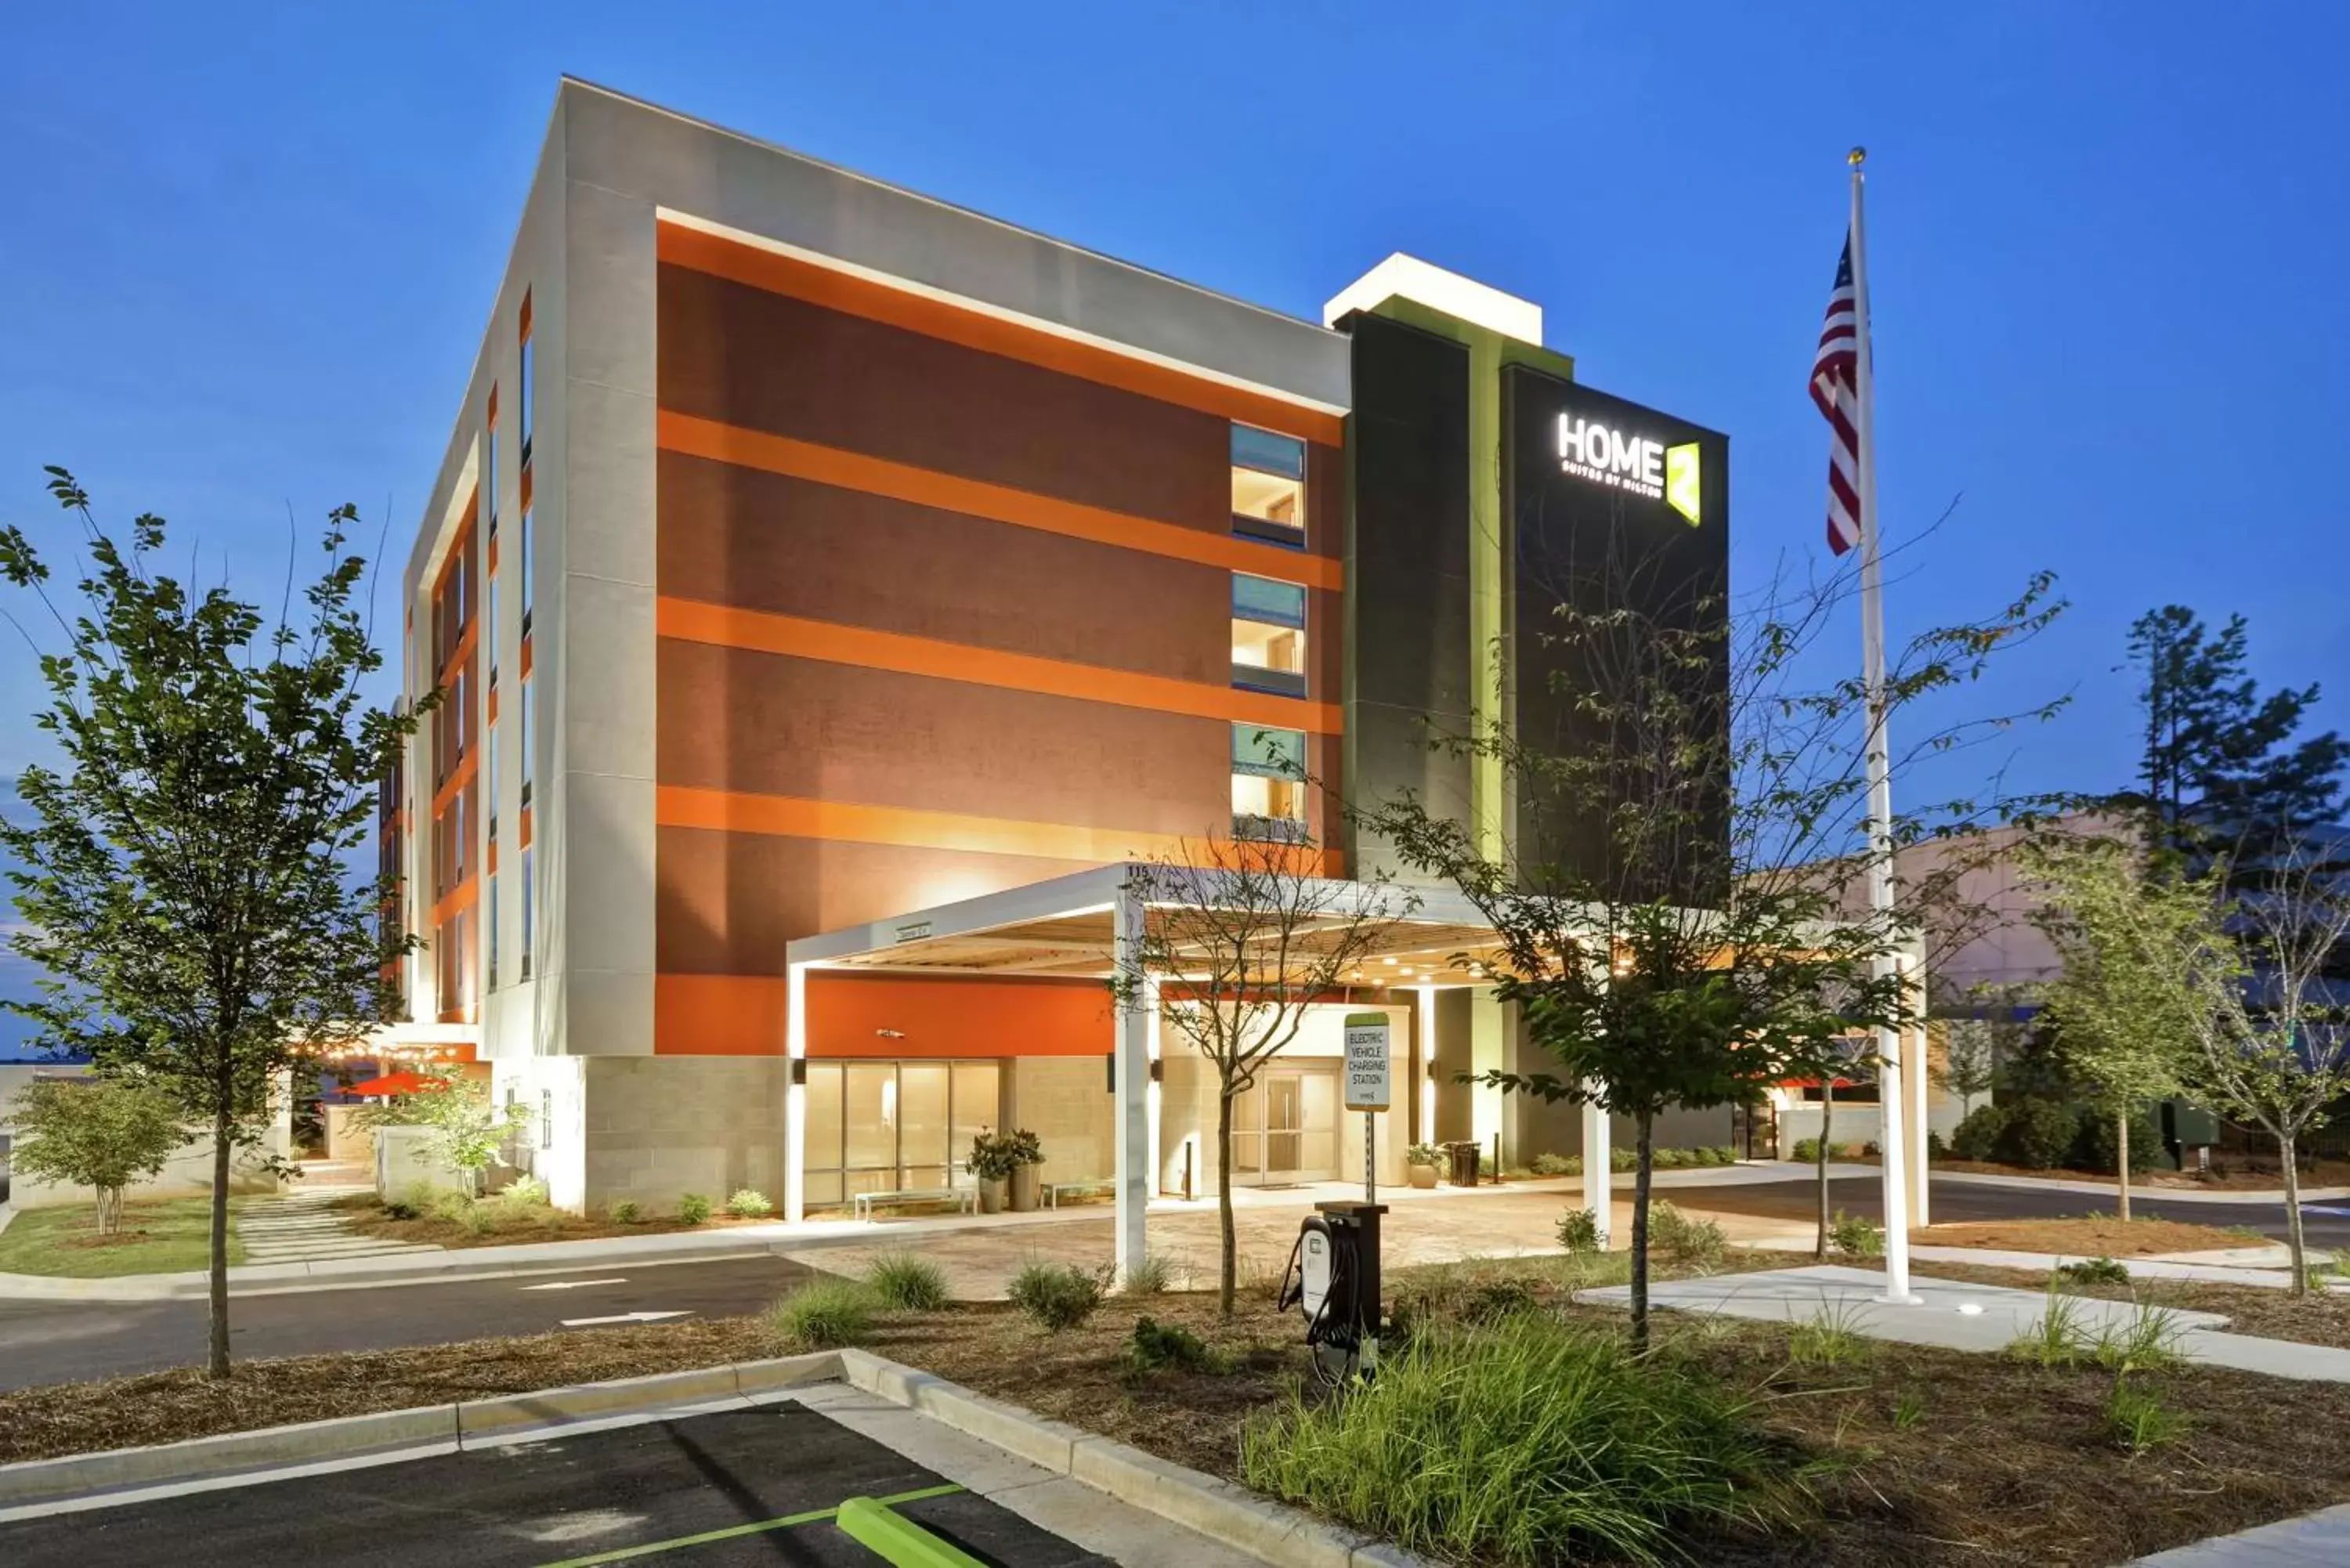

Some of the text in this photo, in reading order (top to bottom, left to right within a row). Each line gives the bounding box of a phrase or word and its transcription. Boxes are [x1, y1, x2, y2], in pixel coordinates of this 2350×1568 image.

[1558, 412, 1664, 486] HOME
[1562, 460, 1661, 499] SUITES BY HILTON
[1350, 1033, 1383, 1044] ELECTRIC
[1351, 1046, 1382, 1057] VEHICLE
[1348, 1060, 1386, 1071] CHARGING
[1353, 1074, 1382, 1085] STATION
